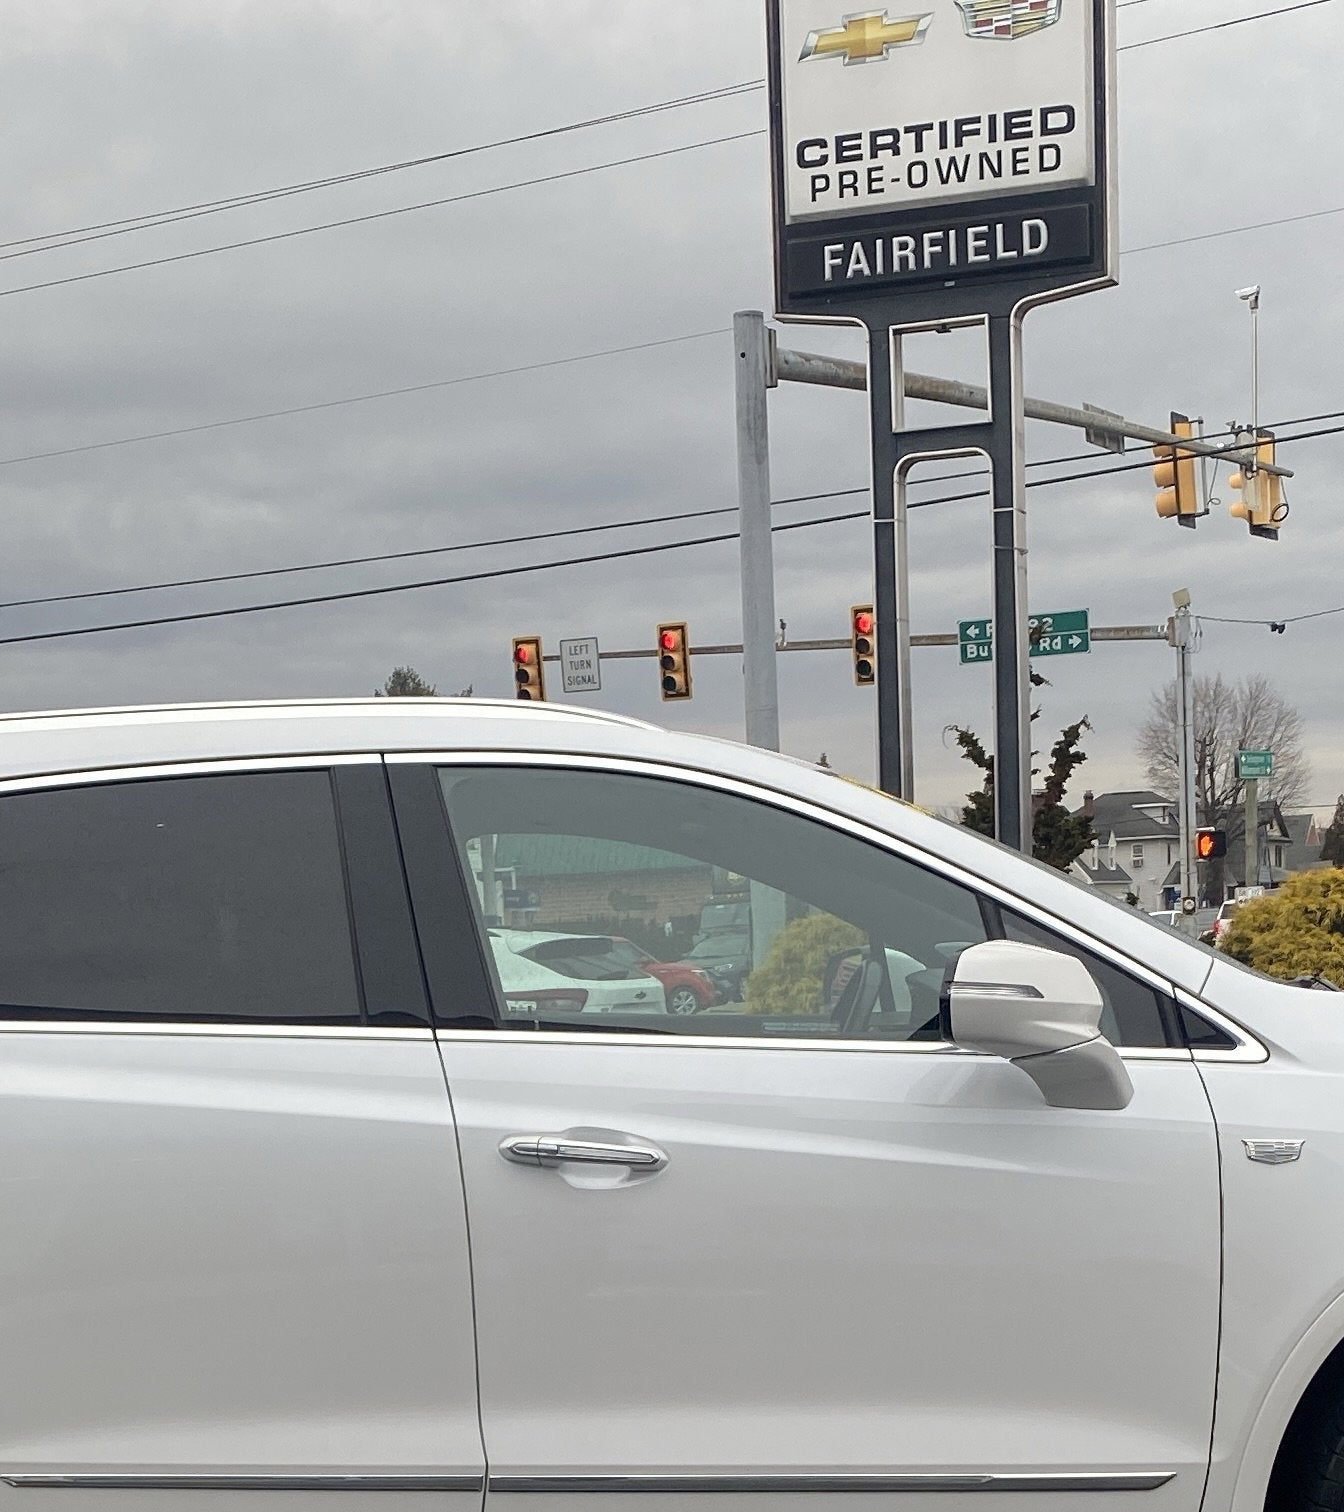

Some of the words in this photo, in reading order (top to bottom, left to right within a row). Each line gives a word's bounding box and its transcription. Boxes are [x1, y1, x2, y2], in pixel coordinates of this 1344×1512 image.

[796, 104, 1076, 169] CERTIFIED
[810, 143, 1062, 203] PRE-OWNED
[823, 218, 1050, 282] FAIRFIELD
[568, 644, 589, 656] LEFT
[1039, 635, 1062, 651] Rd
[569, 659, 592, 671] TURN
[567, 674, 598, 687] SIGNAL
